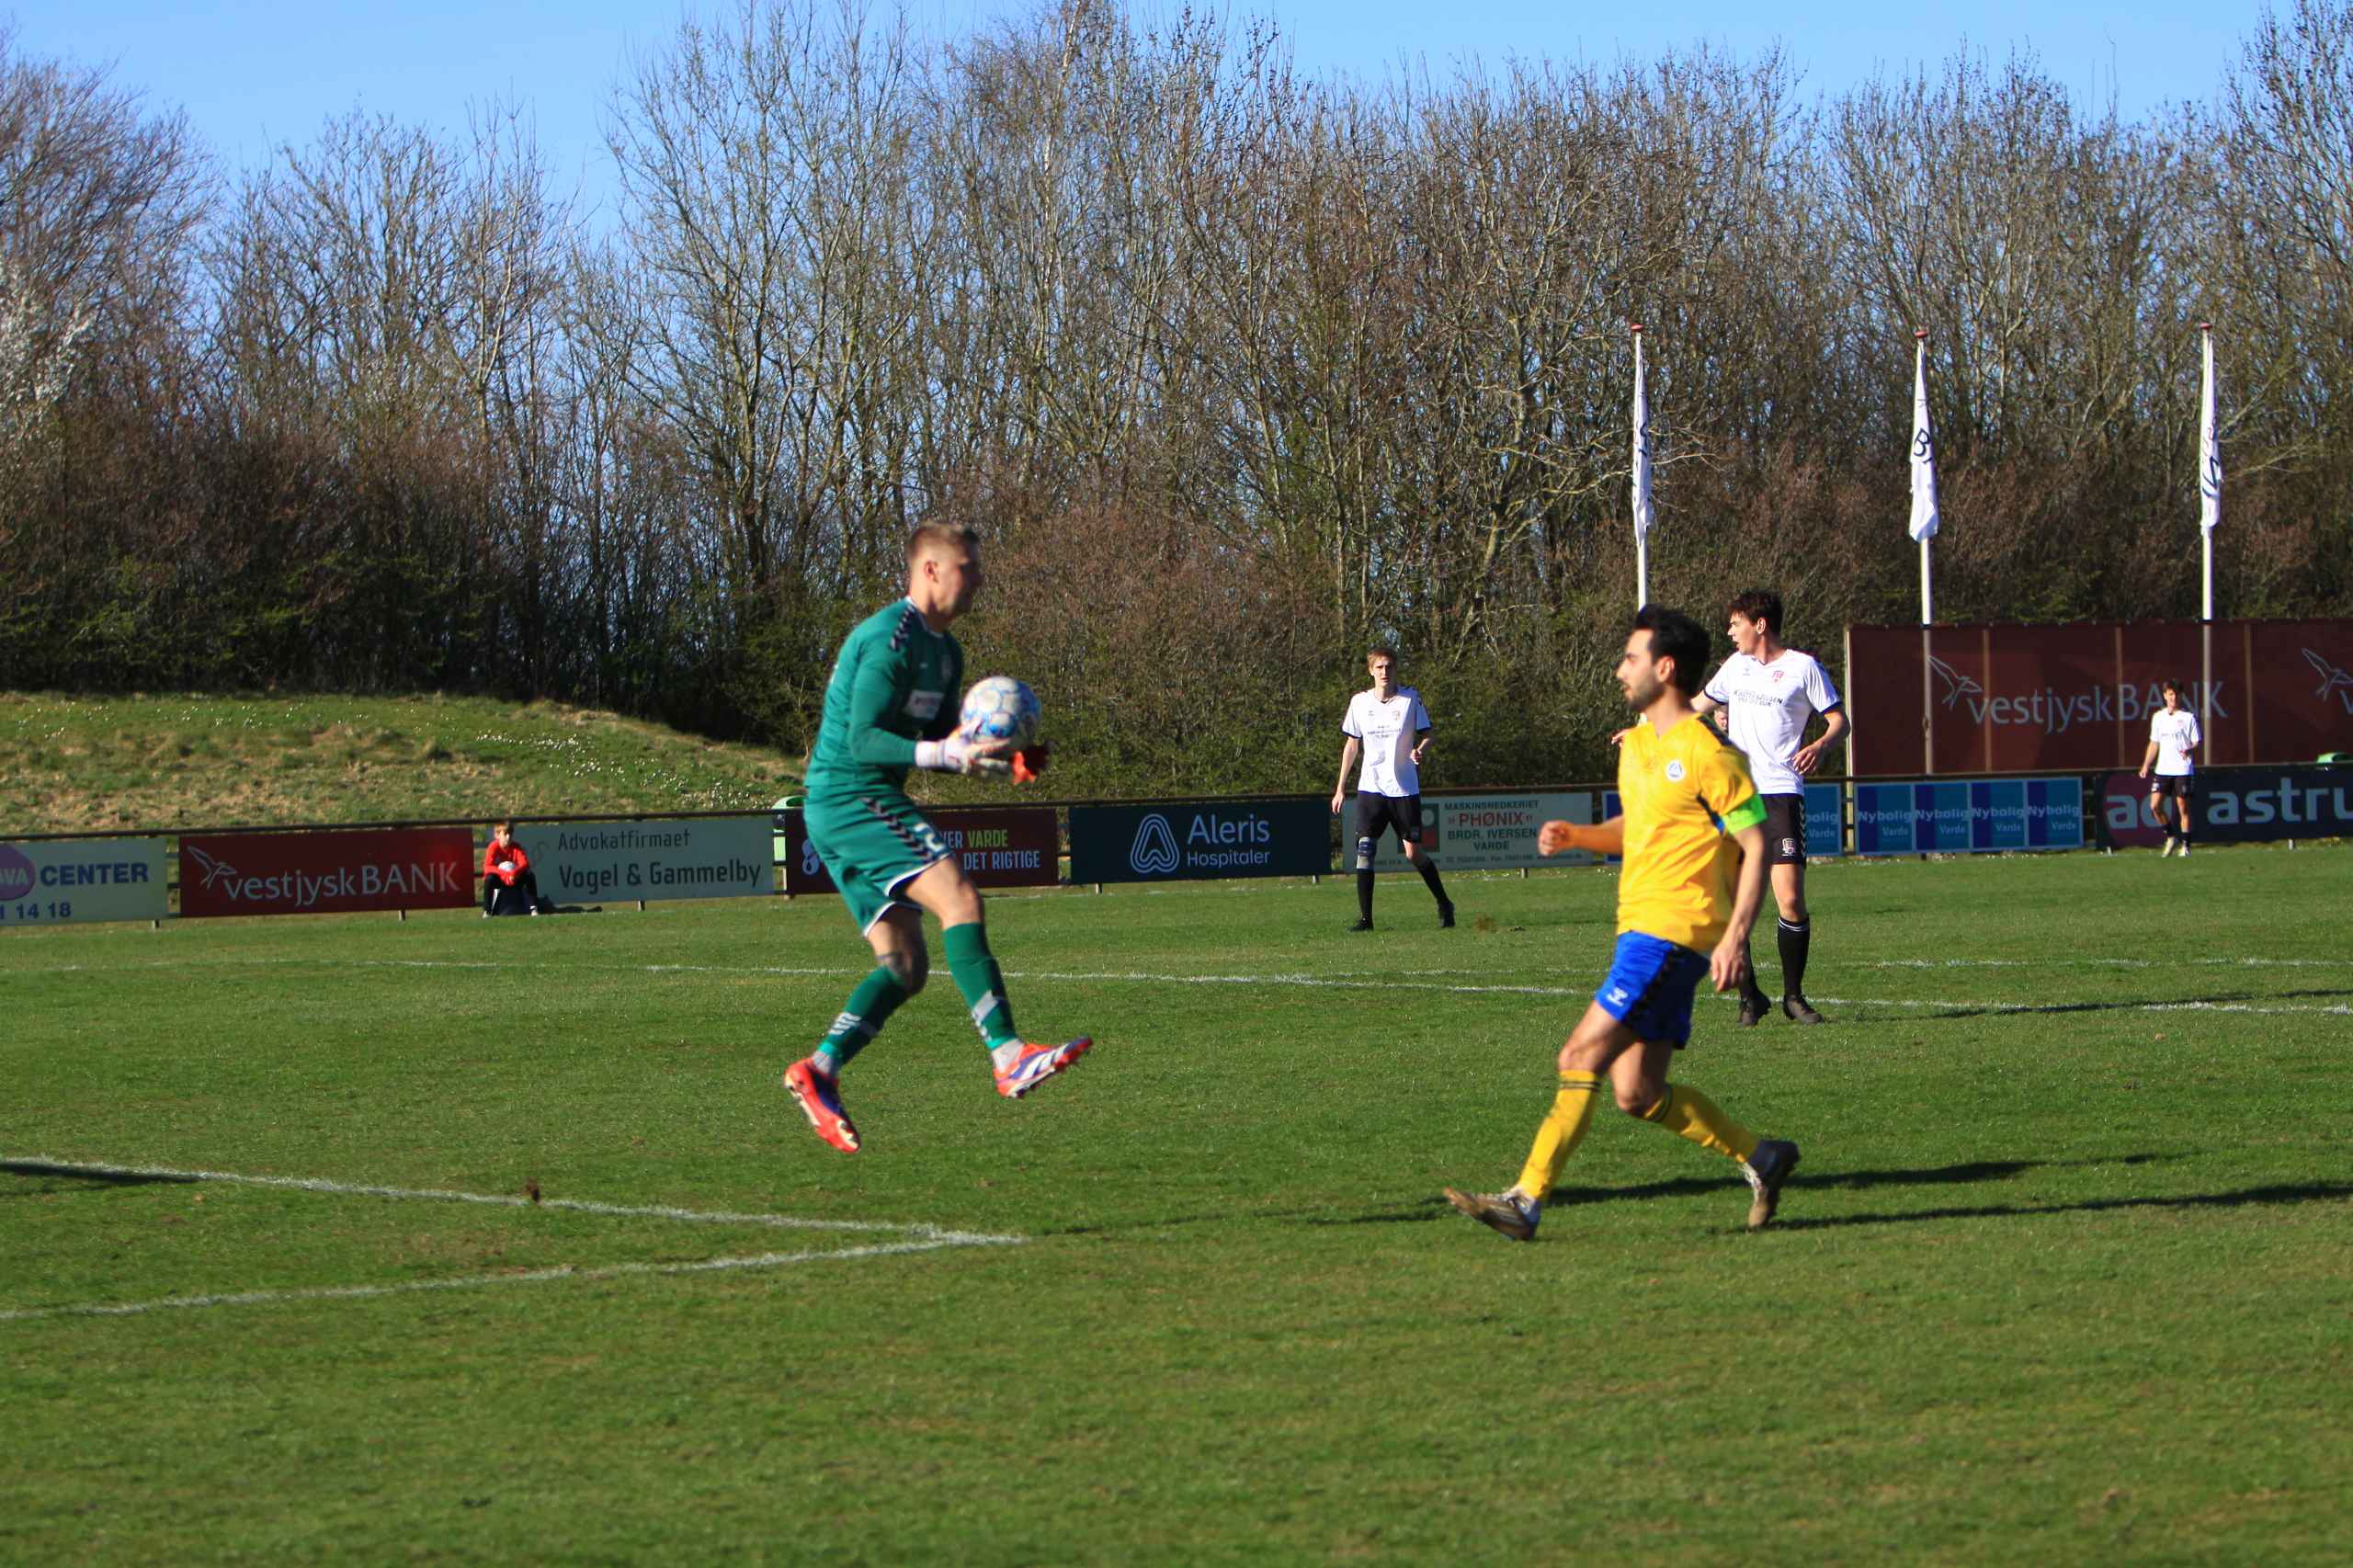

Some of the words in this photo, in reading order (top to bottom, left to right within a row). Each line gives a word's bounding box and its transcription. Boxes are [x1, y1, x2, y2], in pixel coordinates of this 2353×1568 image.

[1857, 810, 1913, 824] Nybolig
[1915, 808, 1970, 822] Nybolig
[1971, 806, 2024, 820] Nybolig
[2026, 804, 2080, 818] Nybolig
[1187, 813, 1270, 845] Aleris
[1485, 826, 1538, 838] IVERSEN
[558, 828, 691, 851] Advokatfirmaet
[967, 829, 1008, 848] VARDE
[1472, 840, 1510, 851] VARDE
[963, 852, 988, 870] DET
[992, 850, 1041, 869] RIGTIGE
[1187, 848, 1270, 868] Hospitaler
[40, 862, 149, 887] CENTER
[558, 863, 619, 894] Vogel
[626, 862, 642, 886] &
[649, 858, 762, 889] Gammelby
[16, 903, 40, 920] 14
[48, 902, 72, 918] 18
